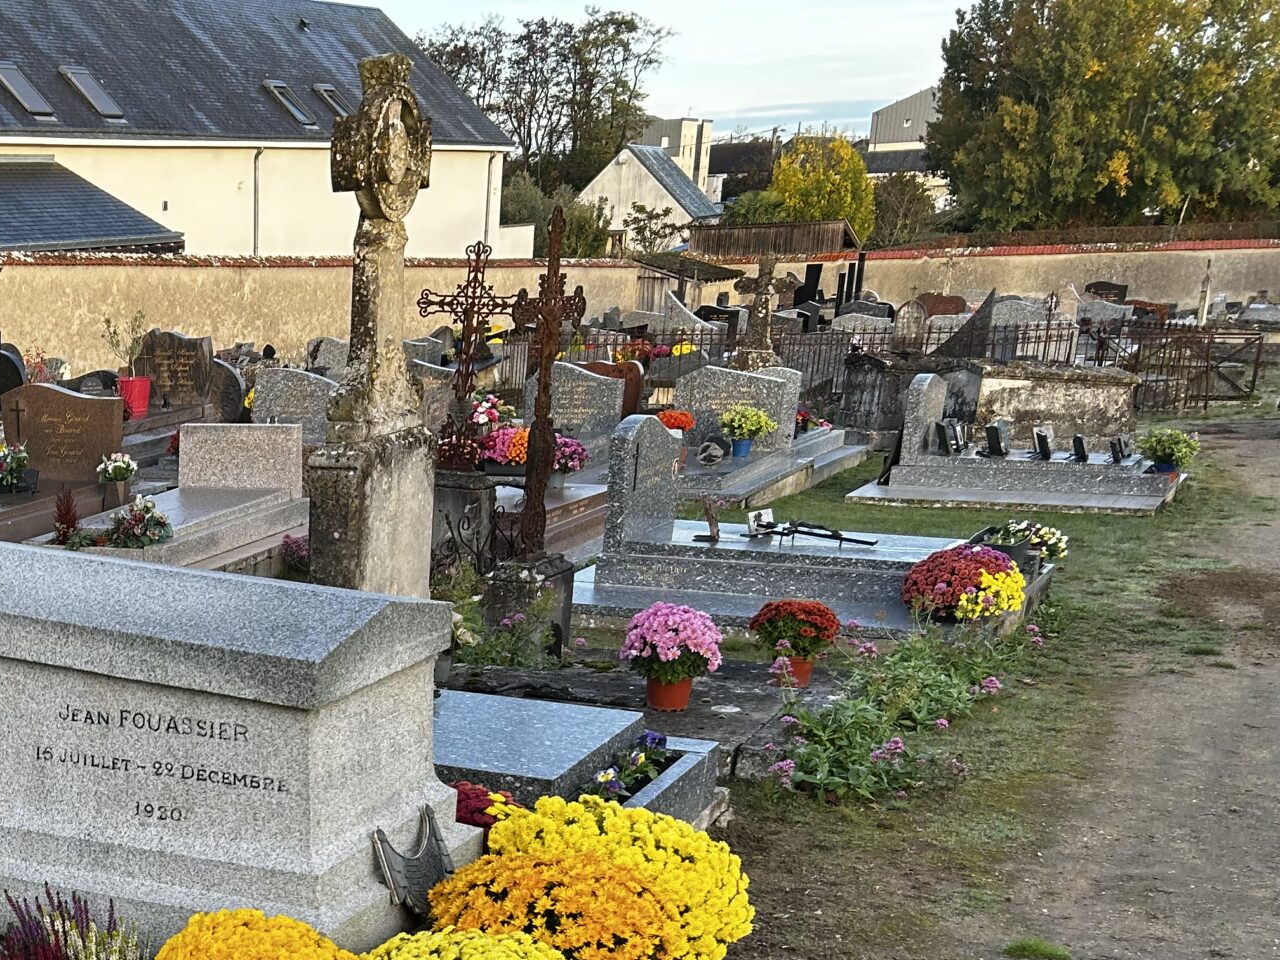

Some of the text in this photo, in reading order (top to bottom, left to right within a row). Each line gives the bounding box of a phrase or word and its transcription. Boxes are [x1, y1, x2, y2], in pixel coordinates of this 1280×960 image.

[58, 704, 249, 742] JEAN FOUASSIER
[59, 750, 131, 773] JUILLET
[153, 761, 174, 778] 22
[134, 801, 182, 822] 1920
